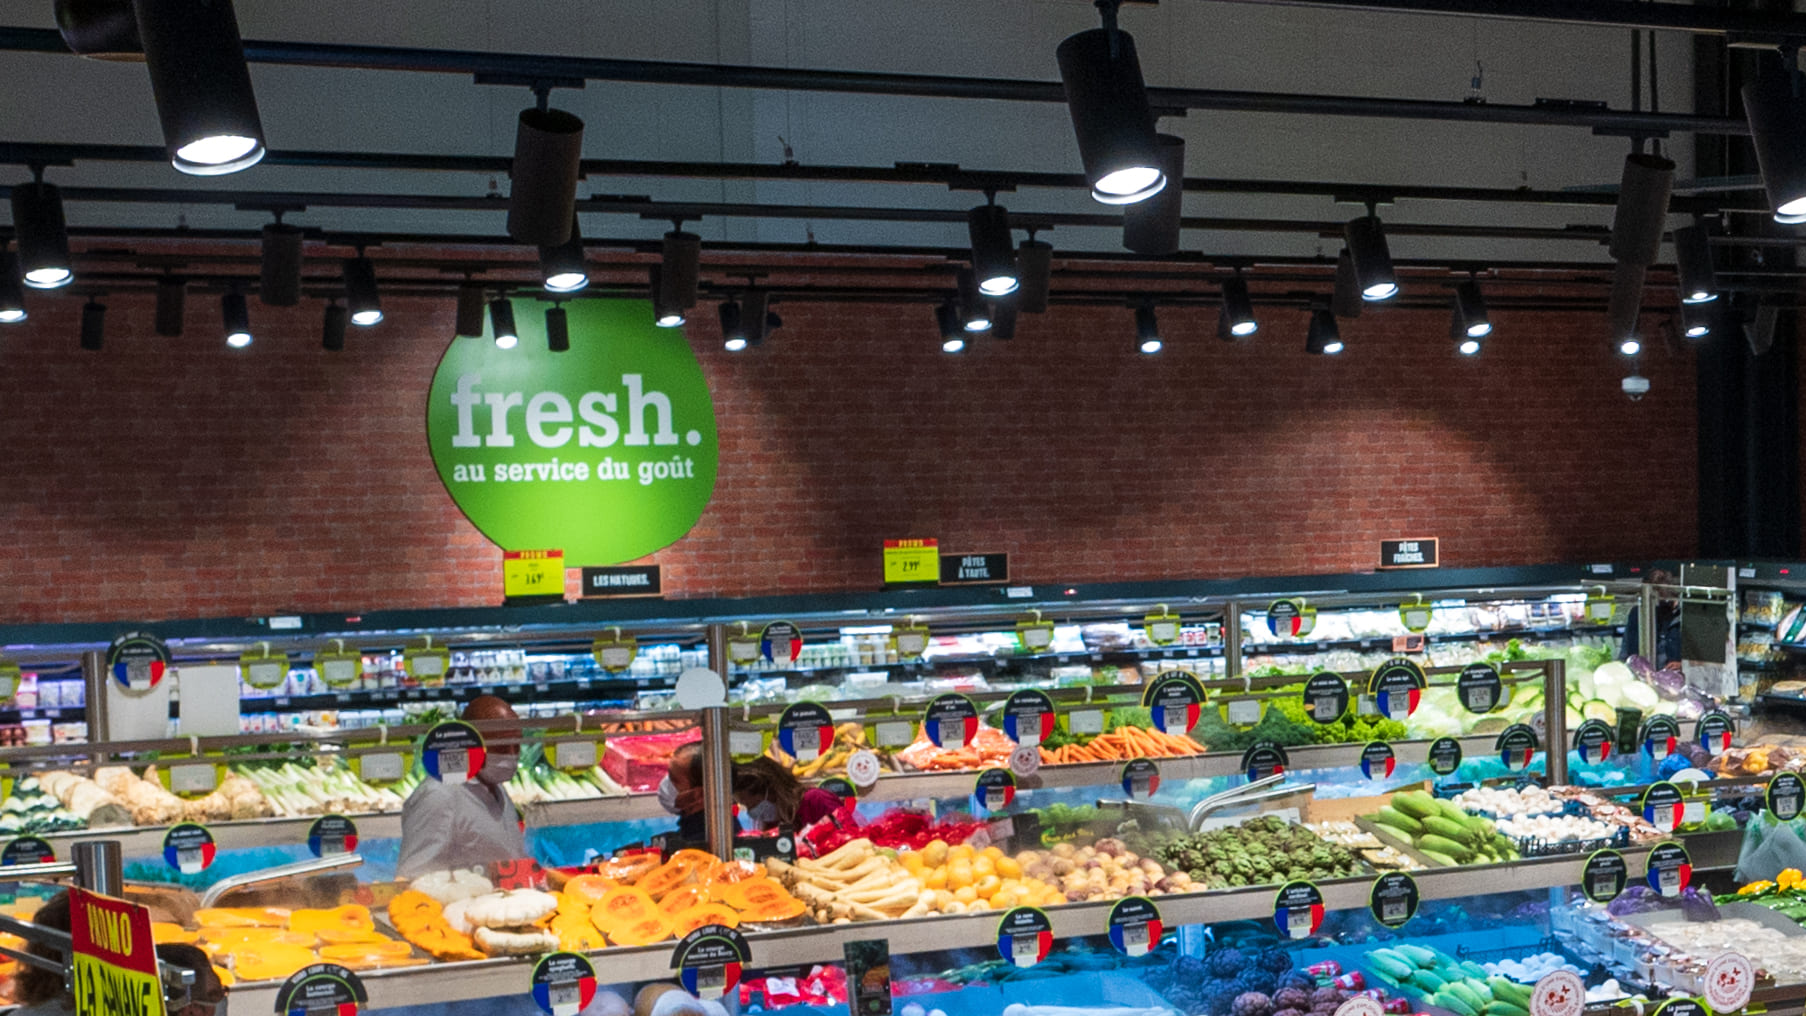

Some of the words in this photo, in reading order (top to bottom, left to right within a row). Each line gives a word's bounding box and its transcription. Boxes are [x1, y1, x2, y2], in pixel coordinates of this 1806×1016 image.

[451, 373, 701, 447] fresh.
[453, 463, 486, 483] au
[494, 457, 590, 482] service
[597, 456, 630, 480] du
[638, 455, 694, 485] goût
